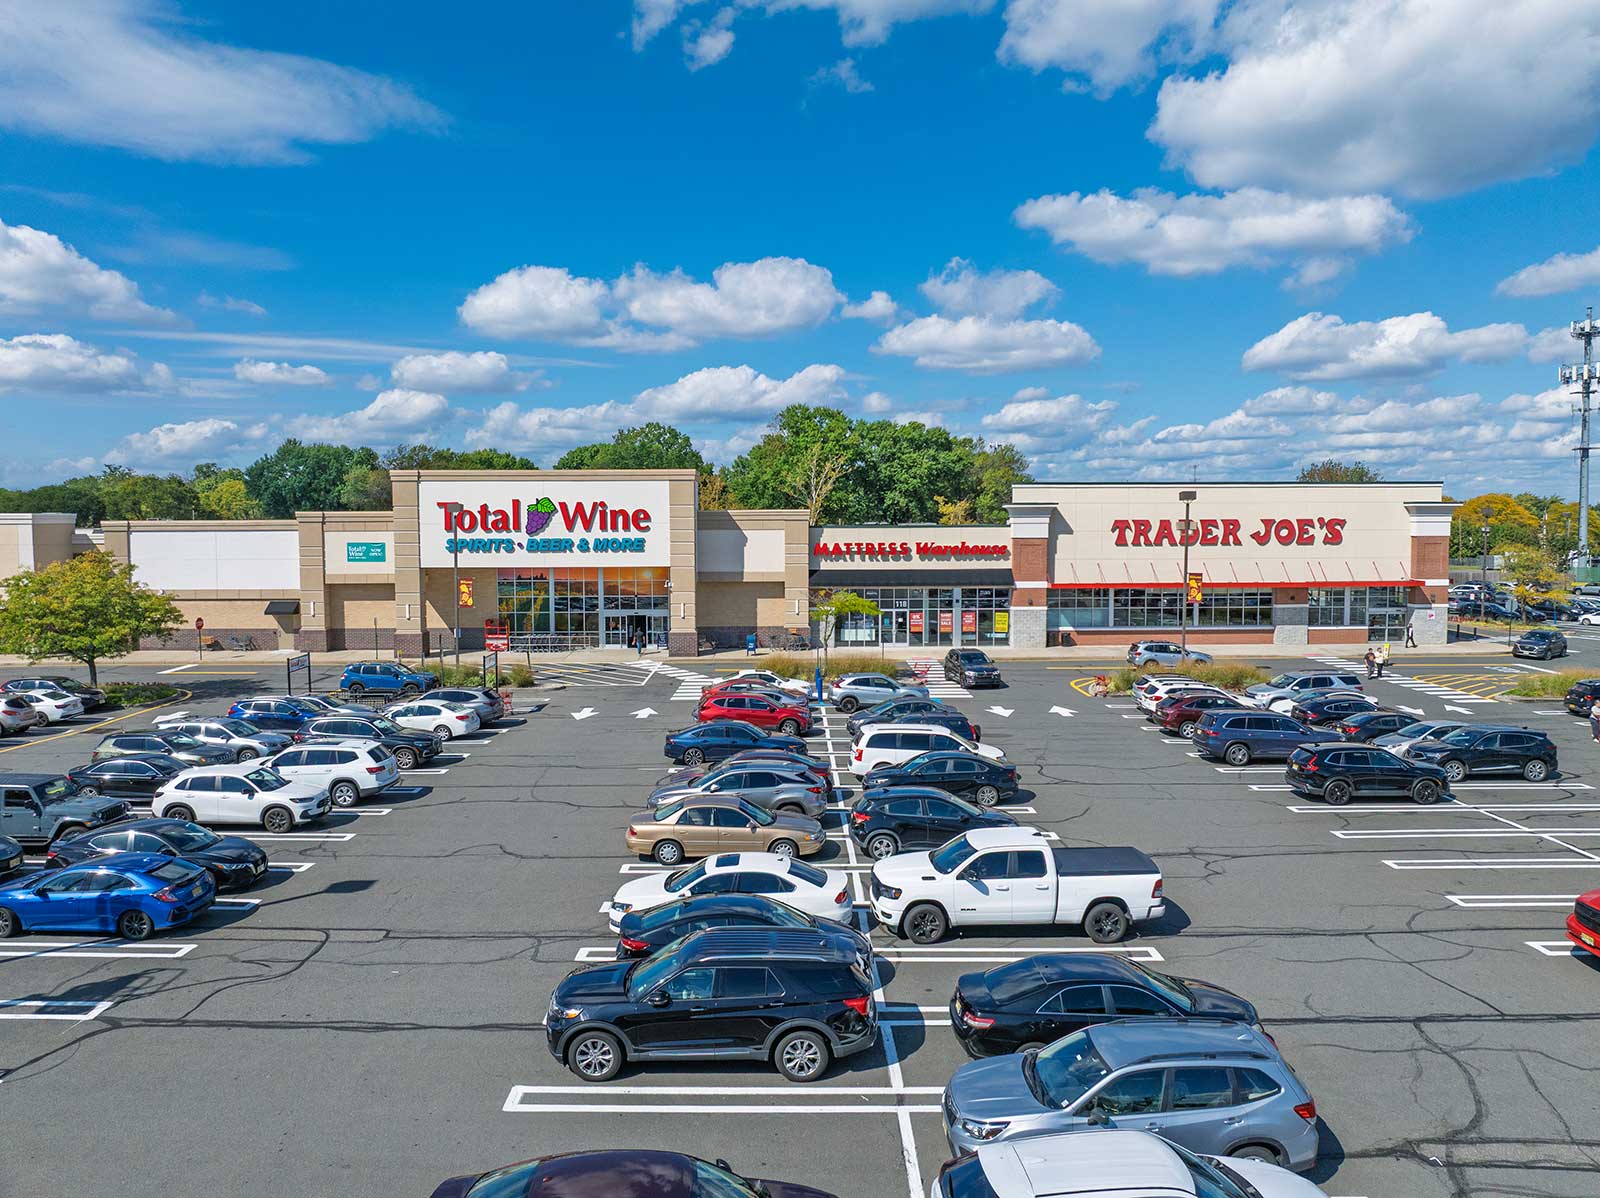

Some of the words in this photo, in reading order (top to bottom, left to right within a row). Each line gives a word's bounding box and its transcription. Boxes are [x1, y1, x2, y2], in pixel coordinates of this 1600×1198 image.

[437, 499, 520, 532] Total
[558, 501, 650, 532] Wine
[1111, 519, 1242, 546] TRADER
[1250, 517, 1347, 546] JOE'S
[446, 538, 514, 552] SPIRITS
[526, 538, 574, 552] BEER
[577, 538, 589, 552] &
[593, 538, 645, 552] MORE
[814, 542, 908, 556] MATTRESS
[915, 541, 1008, 556] Warehouse
